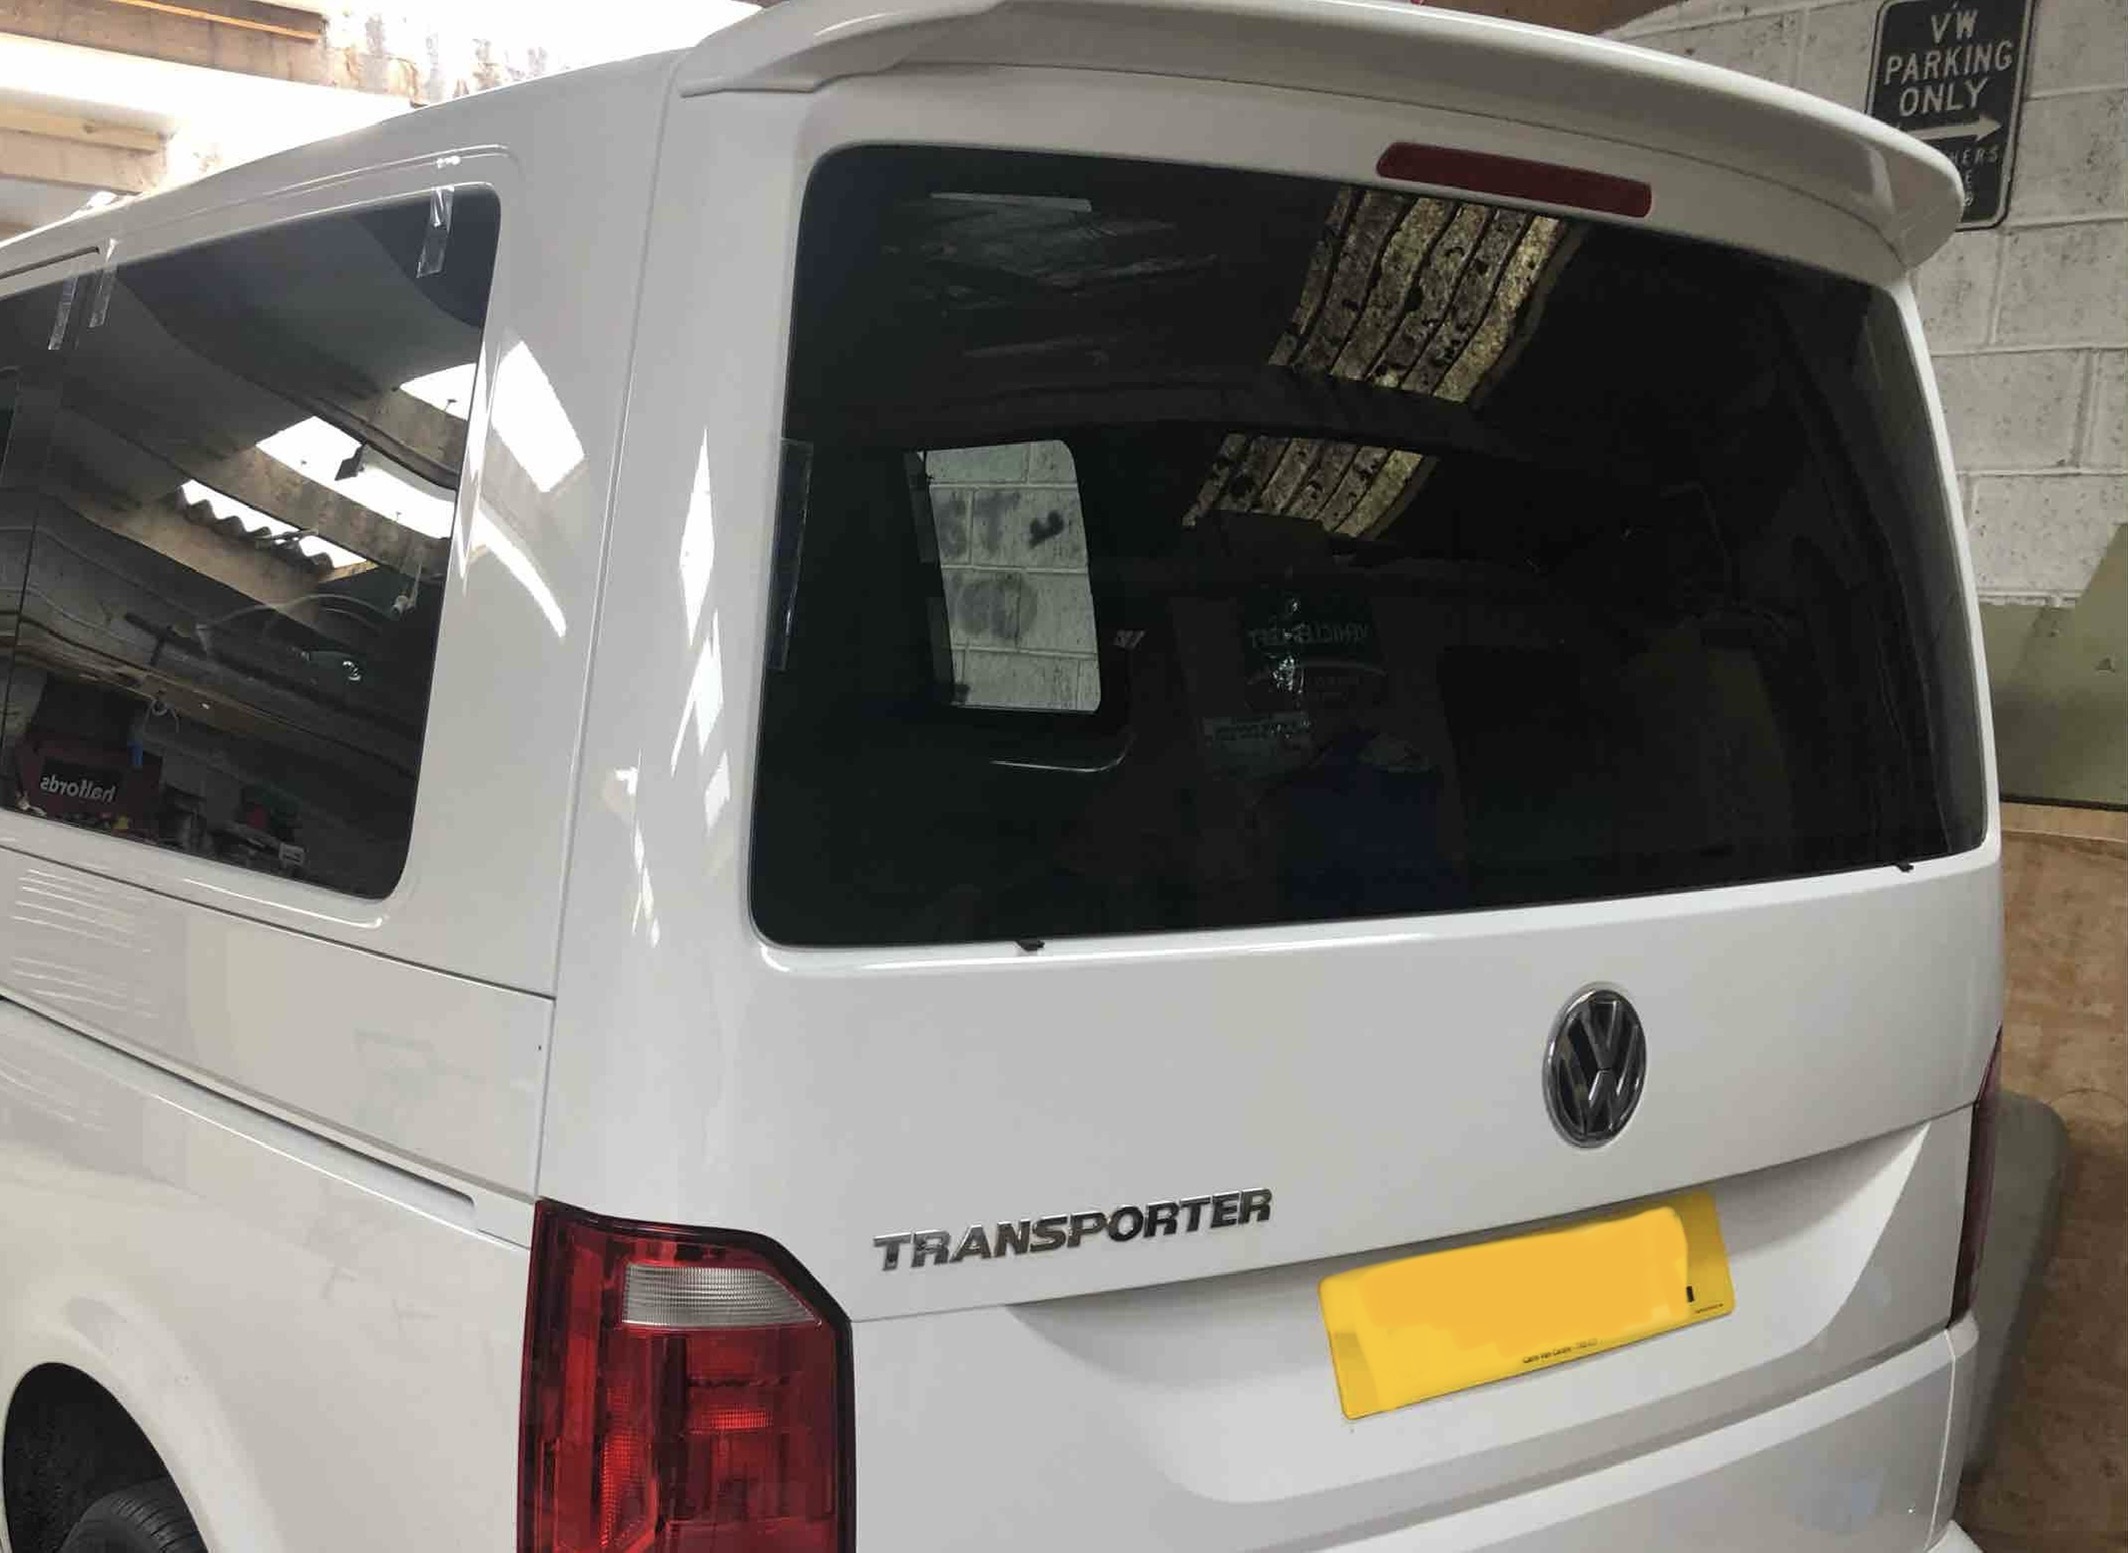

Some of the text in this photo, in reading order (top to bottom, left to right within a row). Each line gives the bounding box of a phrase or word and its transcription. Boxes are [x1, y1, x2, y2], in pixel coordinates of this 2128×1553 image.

[1931, 9, 1978, 44] VW
[1884, 40, 2013, 85] PARKING
[1900, 77, 1988, 117] ONLY
[873, 1187, 1272, 1271] TRANSPORTER
